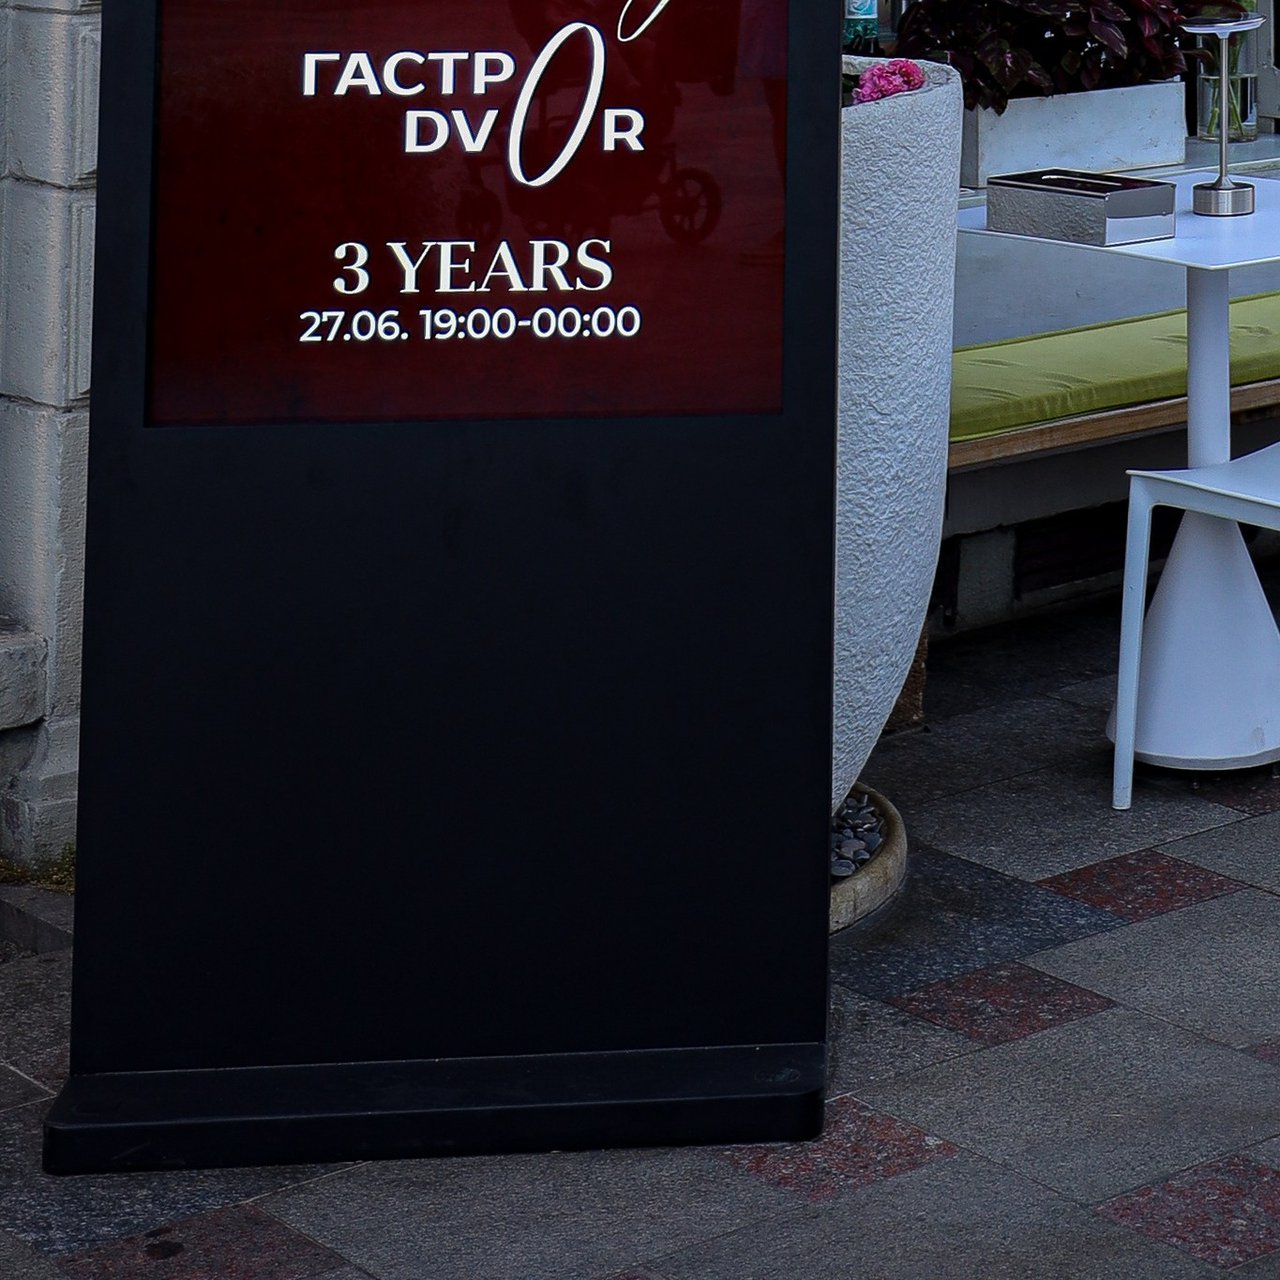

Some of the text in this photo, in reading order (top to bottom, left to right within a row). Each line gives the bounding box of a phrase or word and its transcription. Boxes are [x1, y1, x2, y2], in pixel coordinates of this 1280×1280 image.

[333, 238, 614, 295] 3 YEARS
[419, 305, 642, 340] 19:00-00:00
